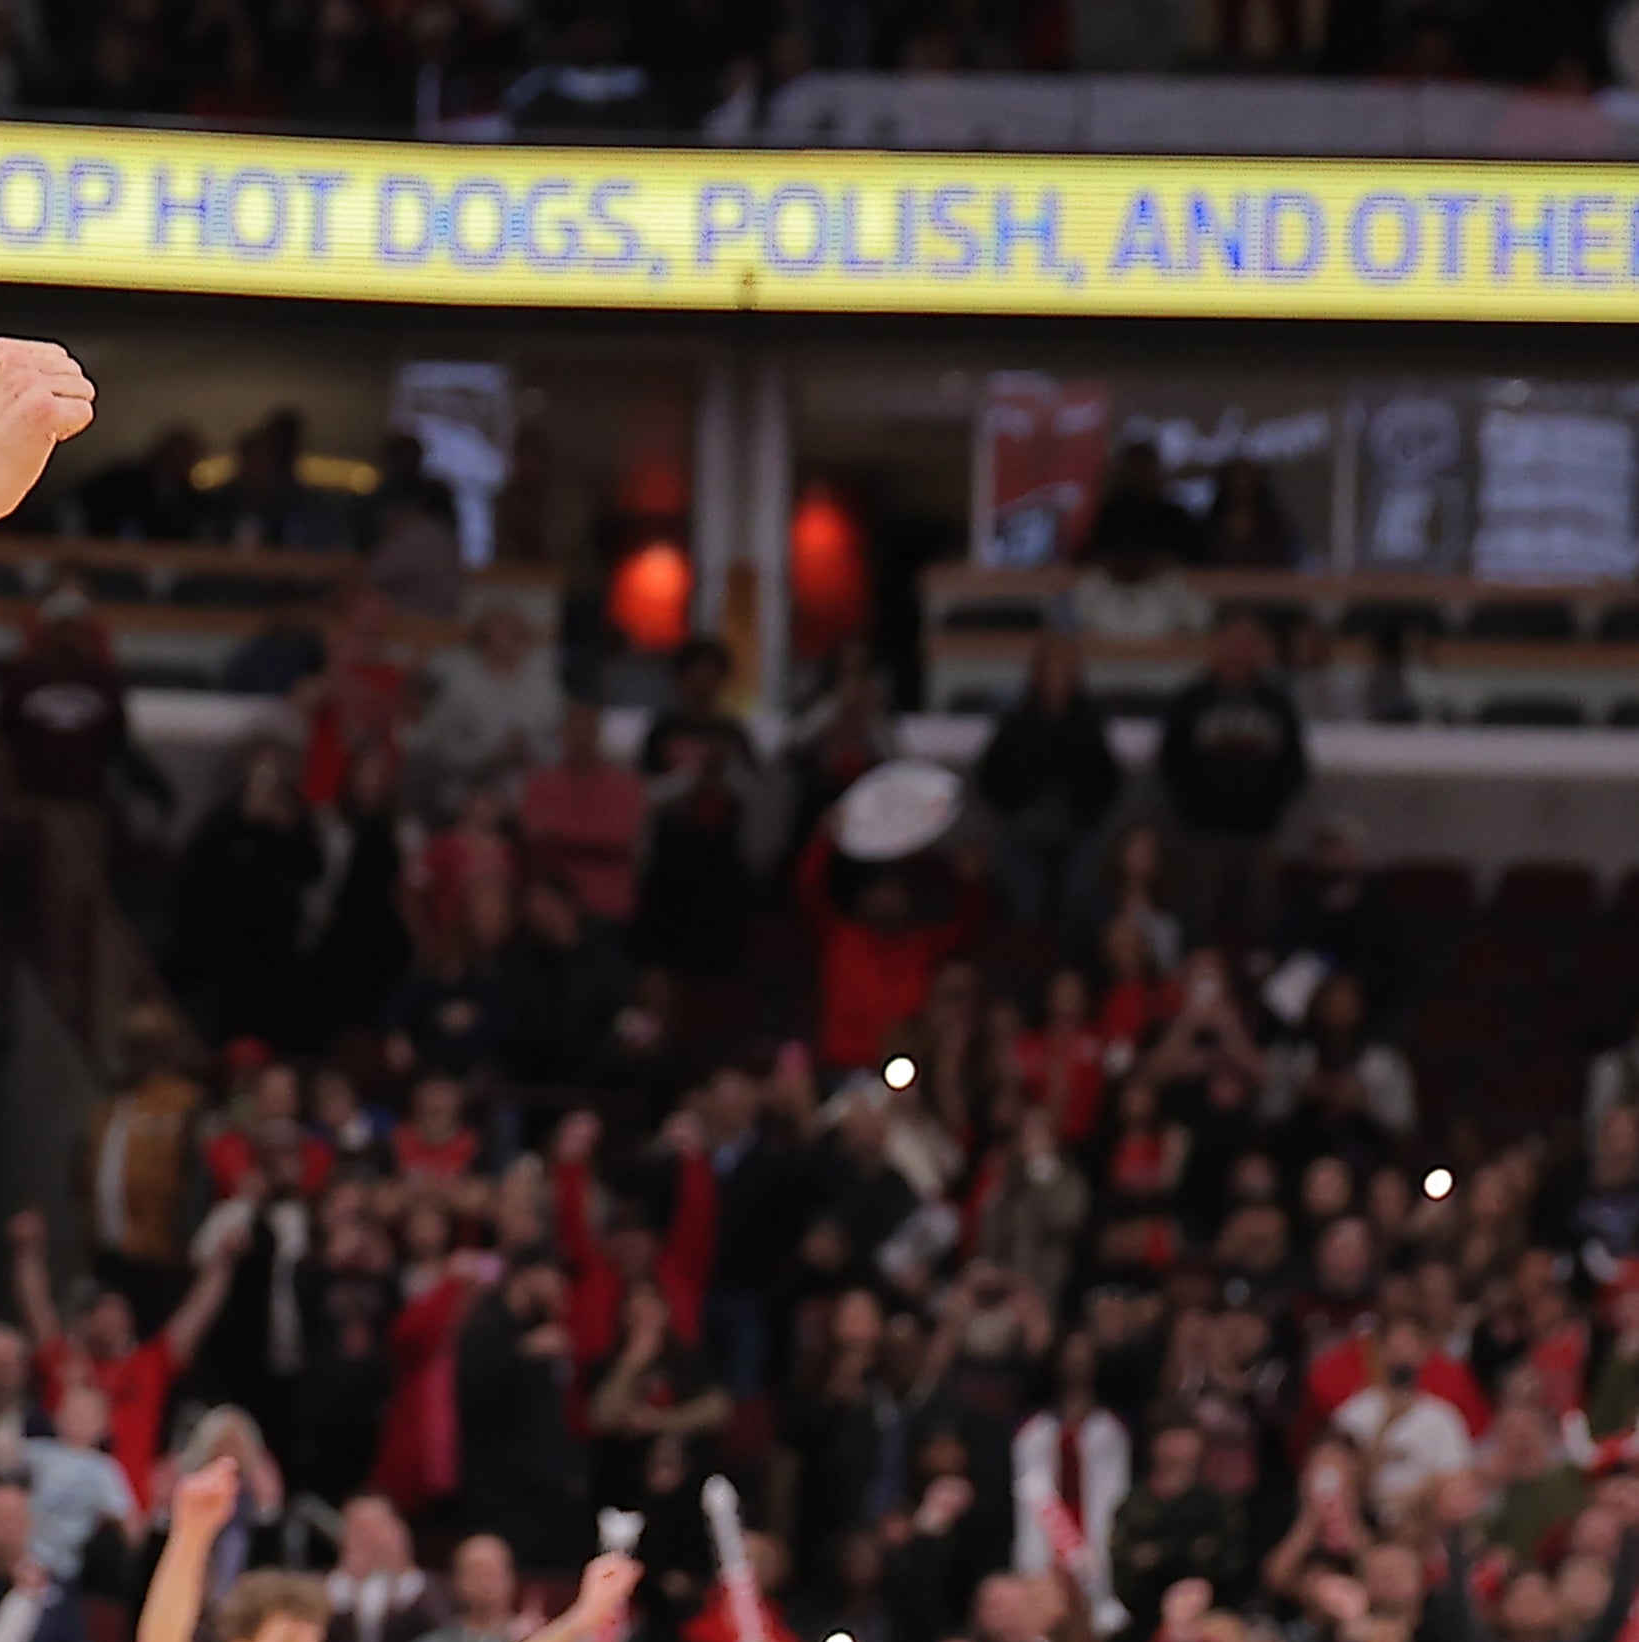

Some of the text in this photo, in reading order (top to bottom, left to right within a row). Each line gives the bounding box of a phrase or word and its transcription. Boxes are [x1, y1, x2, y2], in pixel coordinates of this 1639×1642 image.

[153, 164, 349, 262] HOT
[377, 172, 667, 284] DOGS,
[695, 182, 1085, 292] POLISH,
[1111, 188, 1325, 284] AND
[1347, 190, 1639, 292] OTHE
